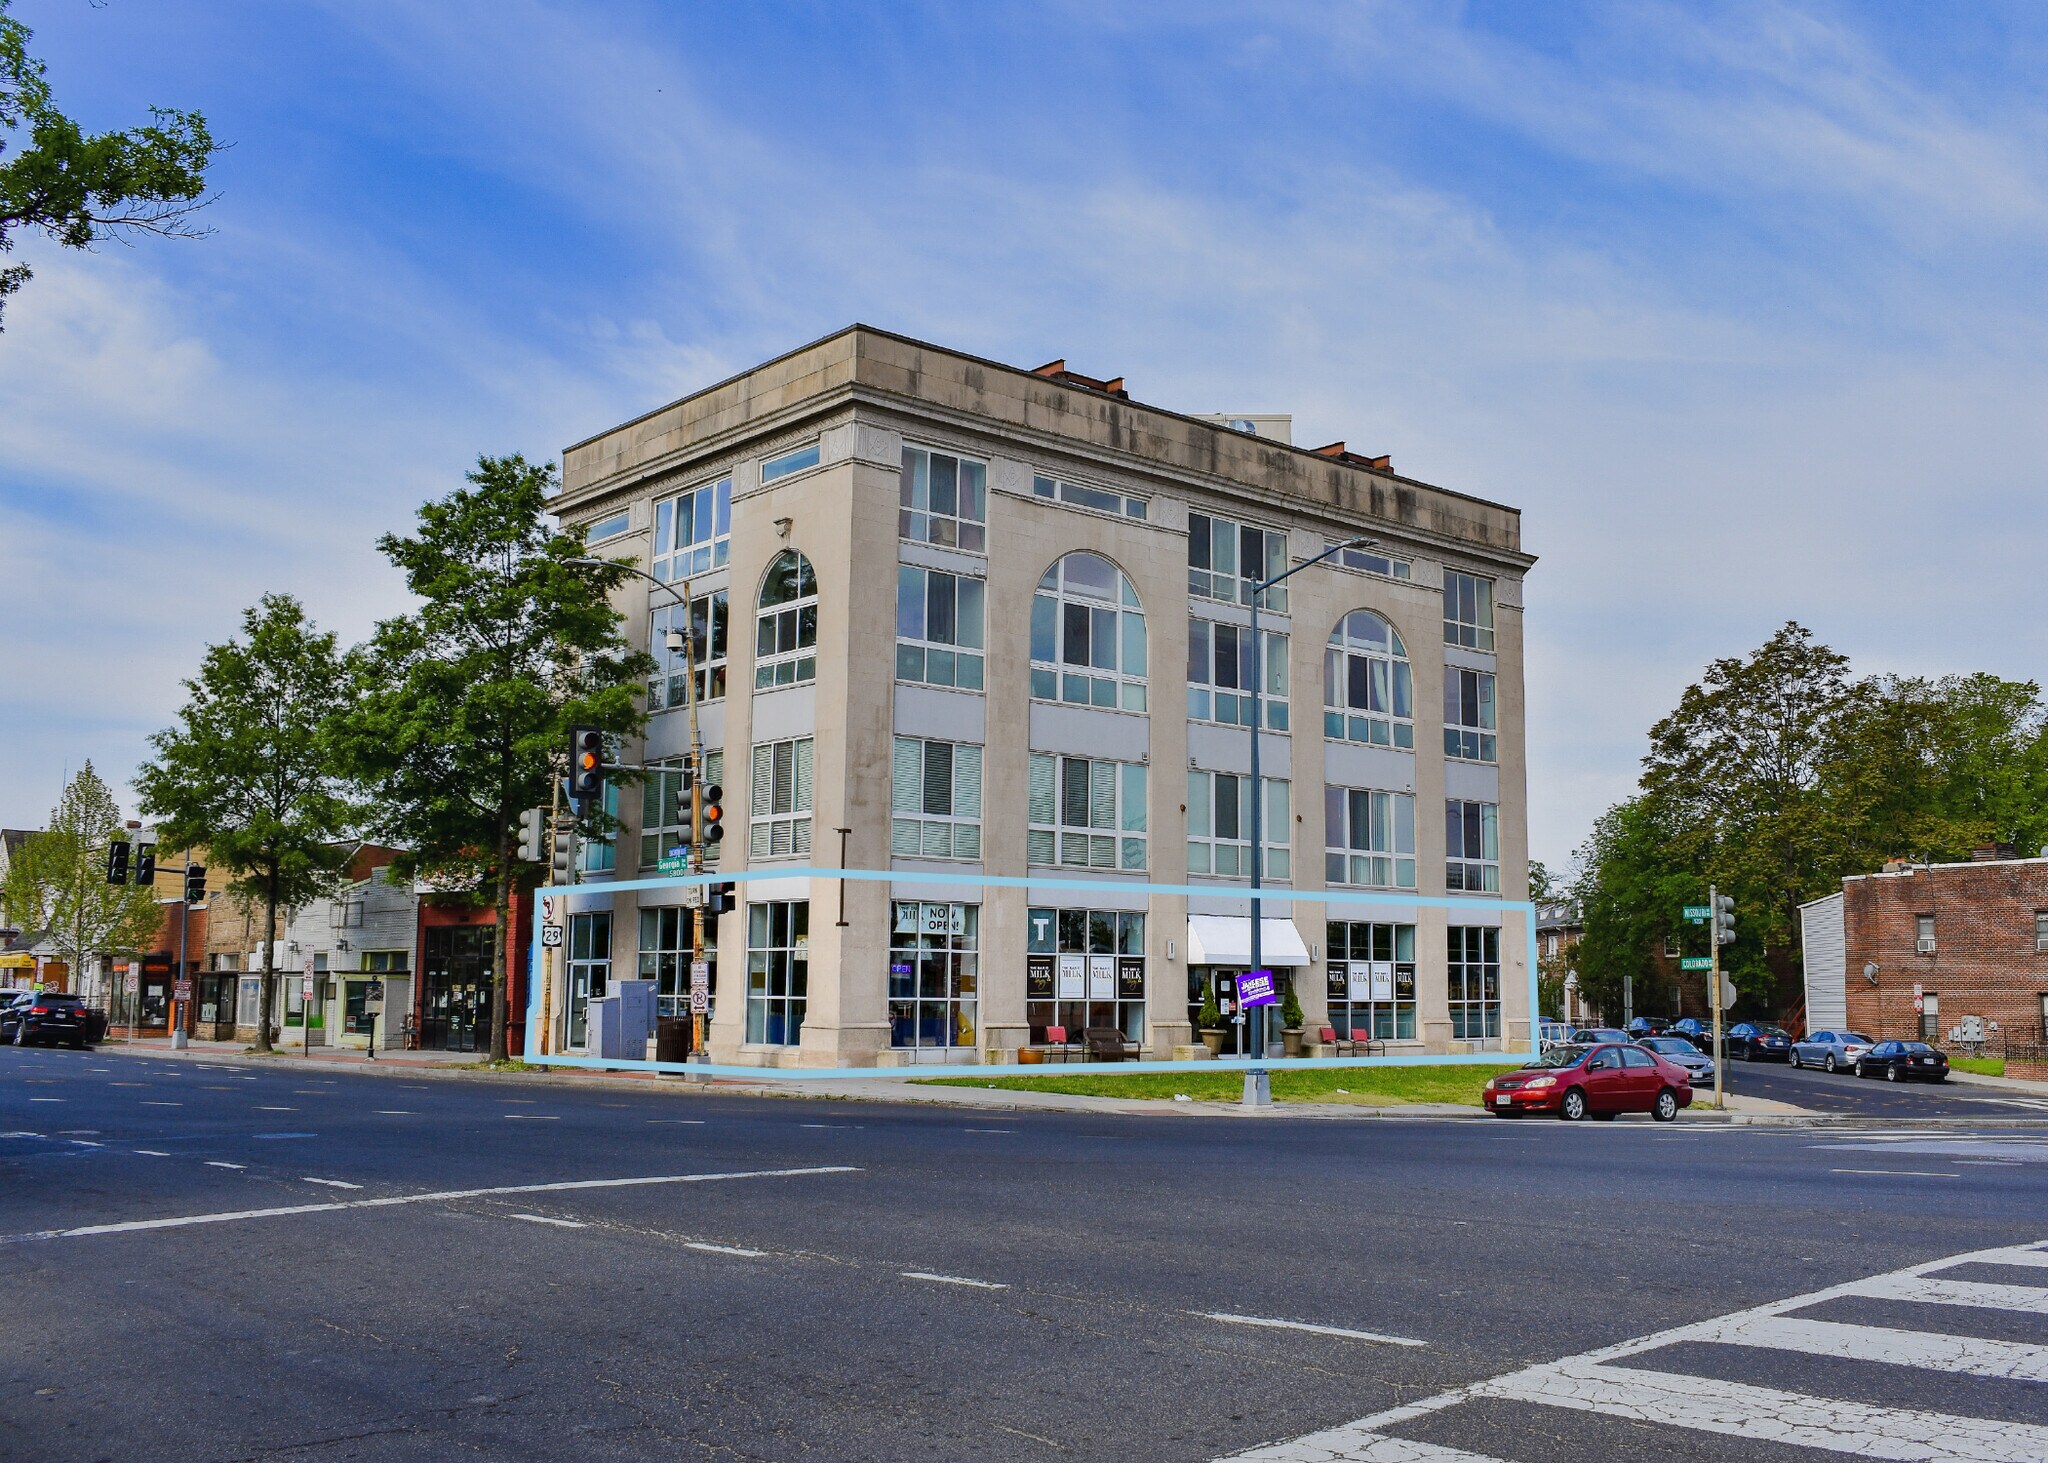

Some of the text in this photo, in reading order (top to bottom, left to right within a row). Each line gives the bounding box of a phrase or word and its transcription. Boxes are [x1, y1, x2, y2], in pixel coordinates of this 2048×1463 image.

[658, 859, 681, 870] Georgia
[1033, 918, 1049, 941] T
[545, 930, 559, 942] 29
[891, 965, 911, 973] OPEN
[1683, 959, 1708, 968] COLORADO
